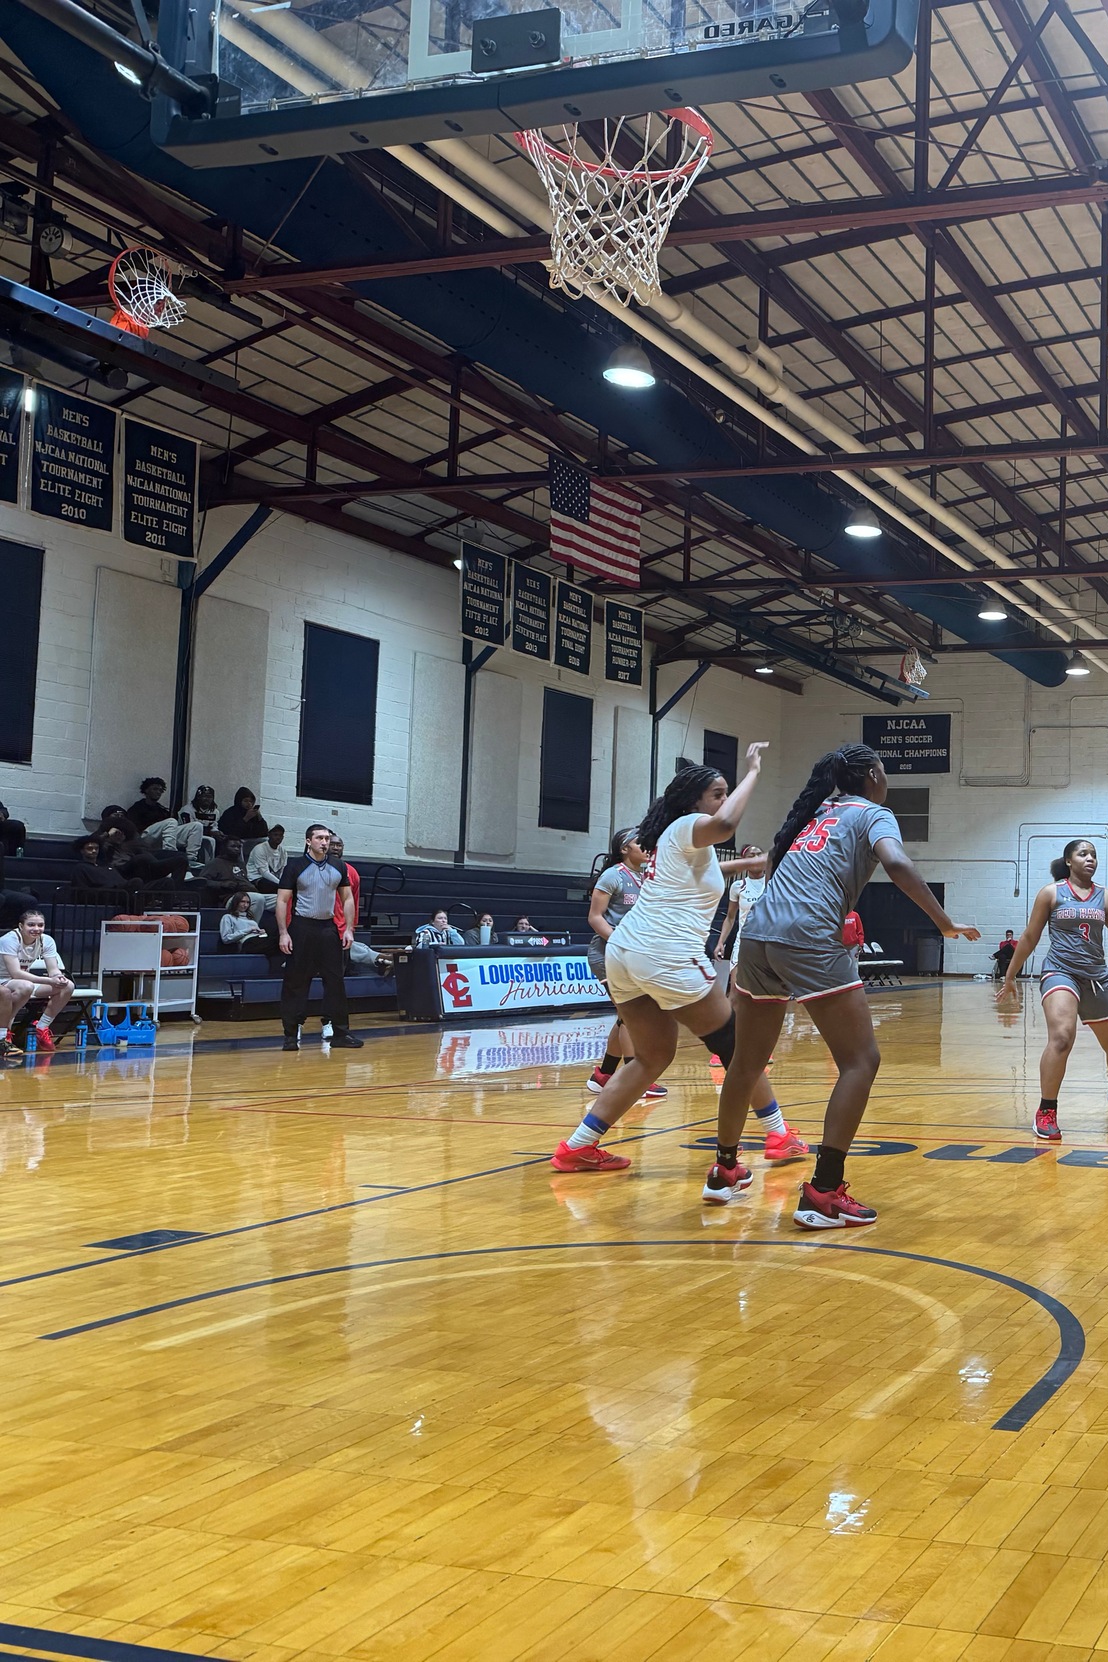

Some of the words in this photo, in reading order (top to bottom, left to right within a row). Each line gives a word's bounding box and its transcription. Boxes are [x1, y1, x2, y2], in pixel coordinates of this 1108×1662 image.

[62, 407, 90, 427] MEN'S
[47, 425, 103, 454] BASKETBALL
[35, 440, 66, 461] NJCAA
[68, 450, 109, 475] NATIONAL
[150, 445, 177, 463] MEN'S
[41, 460, 103, 489] TOURNAMENT
[135, 459, 186, 486] BASKETBALL
[40, 478, 72, 498] ELITE
[75, 489, 103, 508] EIGHT
[127, 475, 154, 492] NJCAA
[155, 484, 192, 504] NATIONAL
[61, 503, 87, 520] 2010
[132, 493, 188, 519] TOURNAMENT
[130, 511, 159, 529] ELITE
[162, 519, 187, 537] EIGHT
[145, 531, 166, 546] 2011
[467, 569, 499, 588] BASKETBALL
[467, 596, 499, 614] TOURNAMENT
[474, 625, 489, 637] 2012
[887, 719, 926, 730] NJCAA
[880, 736, 902, 744] MEN'S
[905, 735, 933, 743] SOCCER
[876, 750, 902, 758] TIONAL
[904, 749, 947, 757] CHAMPIONS
[787, 818, 840, 853] 25
[478, 963, 562, 985] LOUISBURG
[499, 974, 606, 1006] Hurricanes
